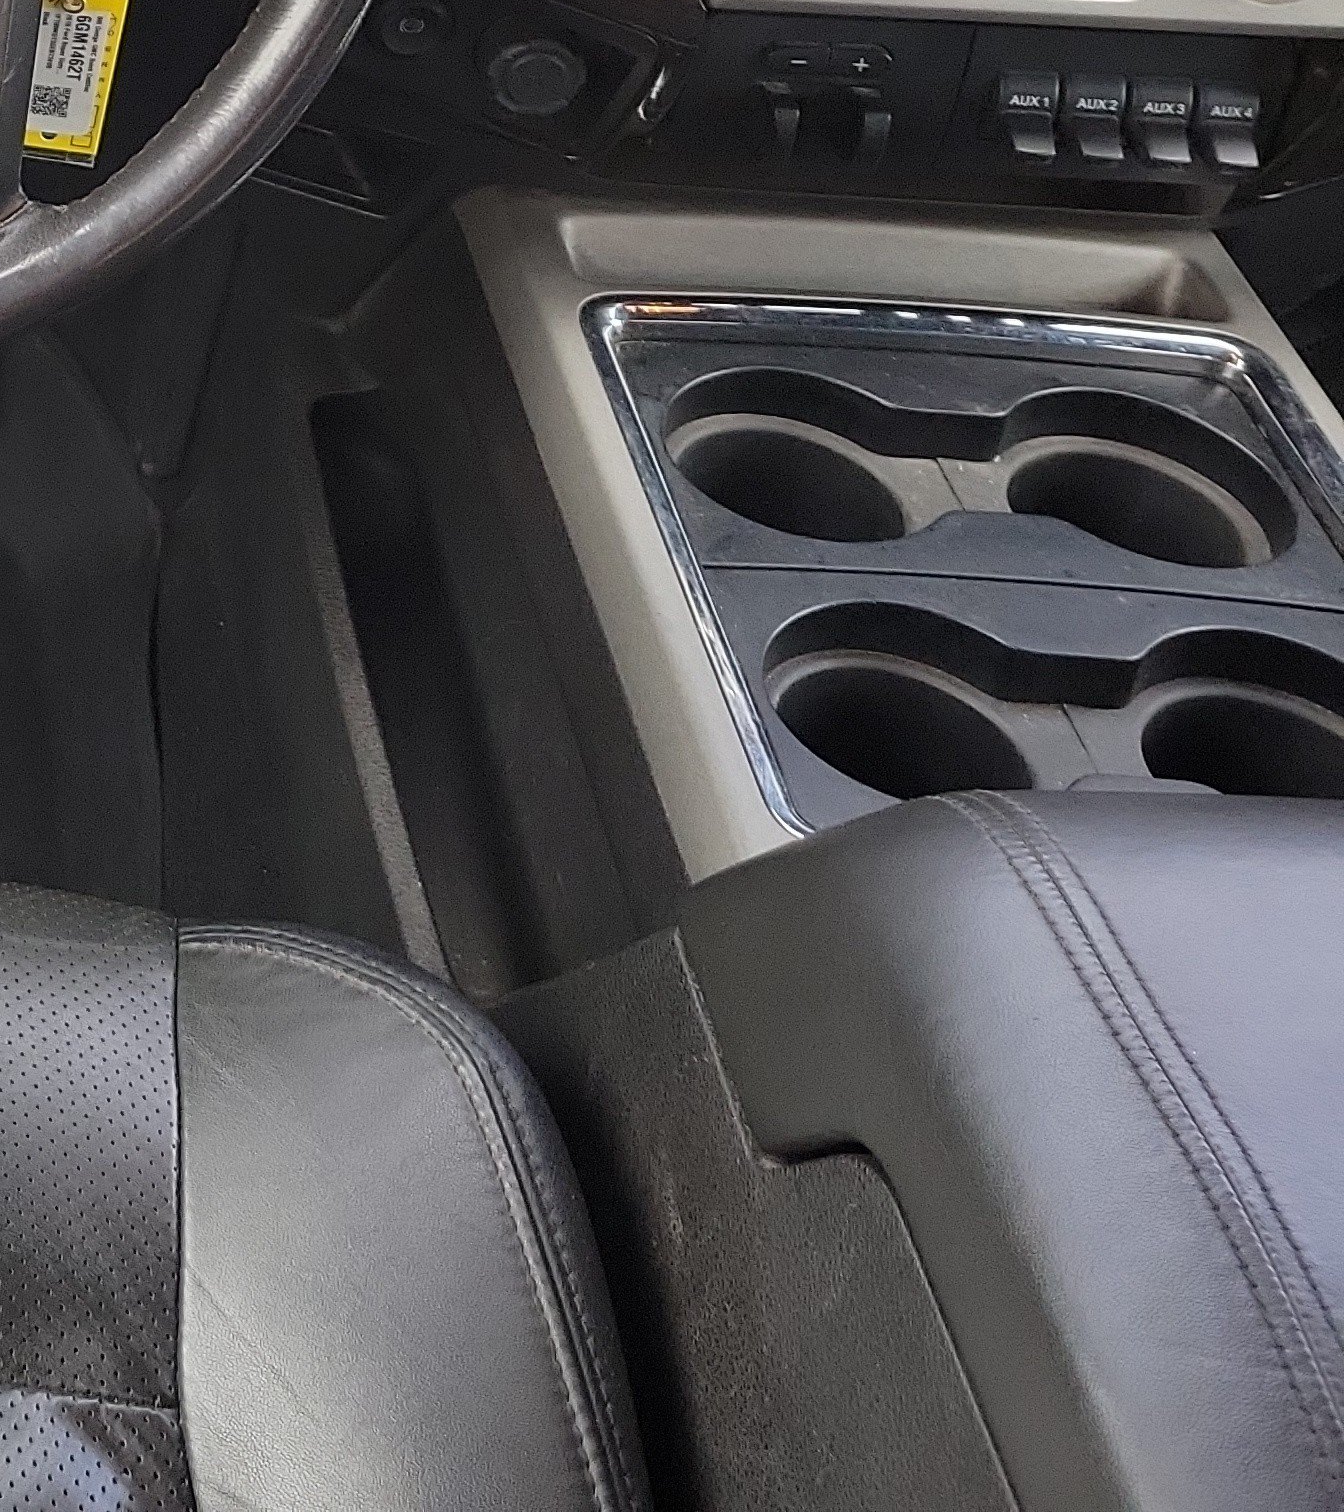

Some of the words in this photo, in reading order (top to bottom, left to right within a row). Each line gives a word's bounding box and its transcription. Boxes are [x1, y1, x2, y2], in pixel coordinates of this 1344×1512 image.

[66, 15, 92, 81] 6GM1462T
[1009, 94, 1040, 107] AUX
[1043, 97, 1050, 107] 1
[1076, 97, 1107, 110] AUX
[1107, 99, 1119, 111] 2
[1143, 102, 1174, 113] AUX
[1175, 103, 1186, 115] 3
[1211, 105, 1242, 117] AUX
[1244, 107, 1253, 118] 4
